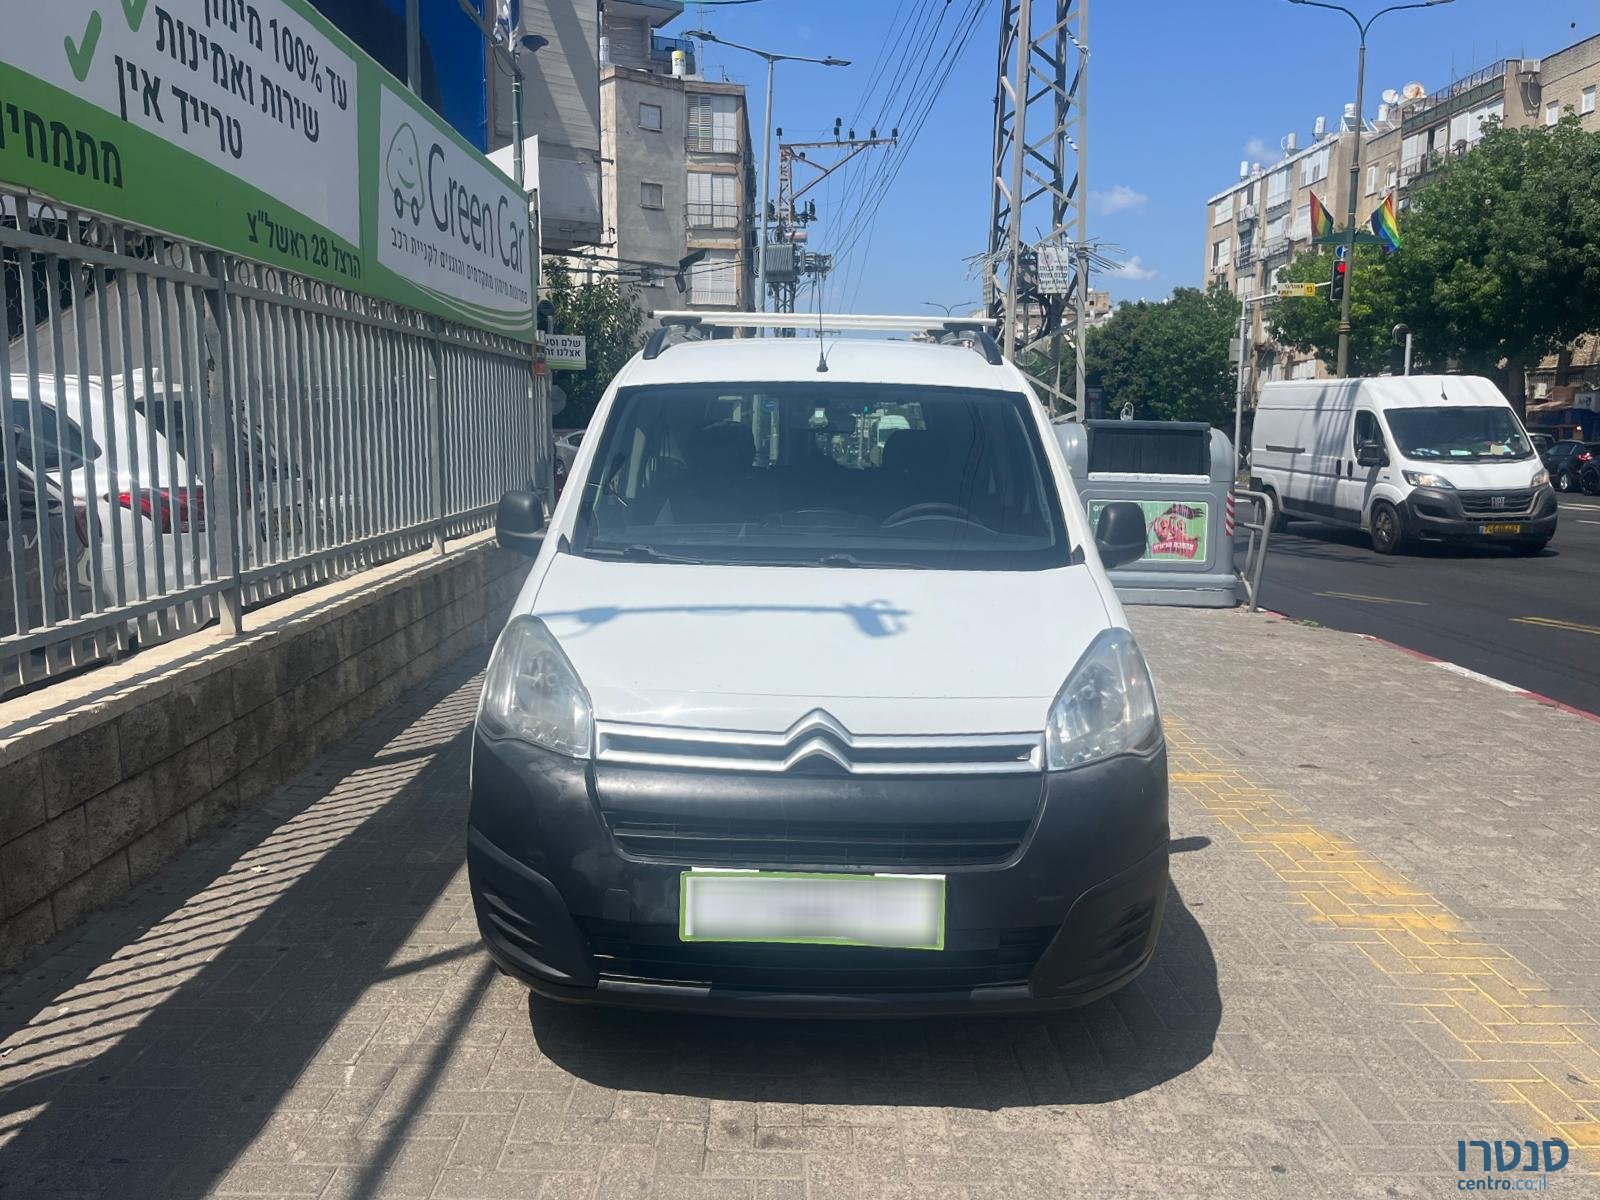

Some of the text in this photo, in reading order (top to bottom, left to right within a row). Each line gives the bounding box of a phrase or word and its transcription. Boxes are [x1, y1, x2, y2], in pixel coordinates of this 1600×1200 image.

[155, 4, 320, 143] שירות ואמינות
[269, 18, 322, 93] 100%
[114, 54, 243, 159] טרייד אין
[325, 66, 347, 111] עד
[0, 100, 123, 189] מתמחי
[428, 143, 525, 274] Green Car
[311, 233, 329, 268] 28
[331, 239, 361, 280] הרצל
[391, 227, 408, 252] רכב
[410, 236, 438, 268] לקניית
[557, 347, 581, 357] אצלנו
[561, 338, 581, 347] שלם
